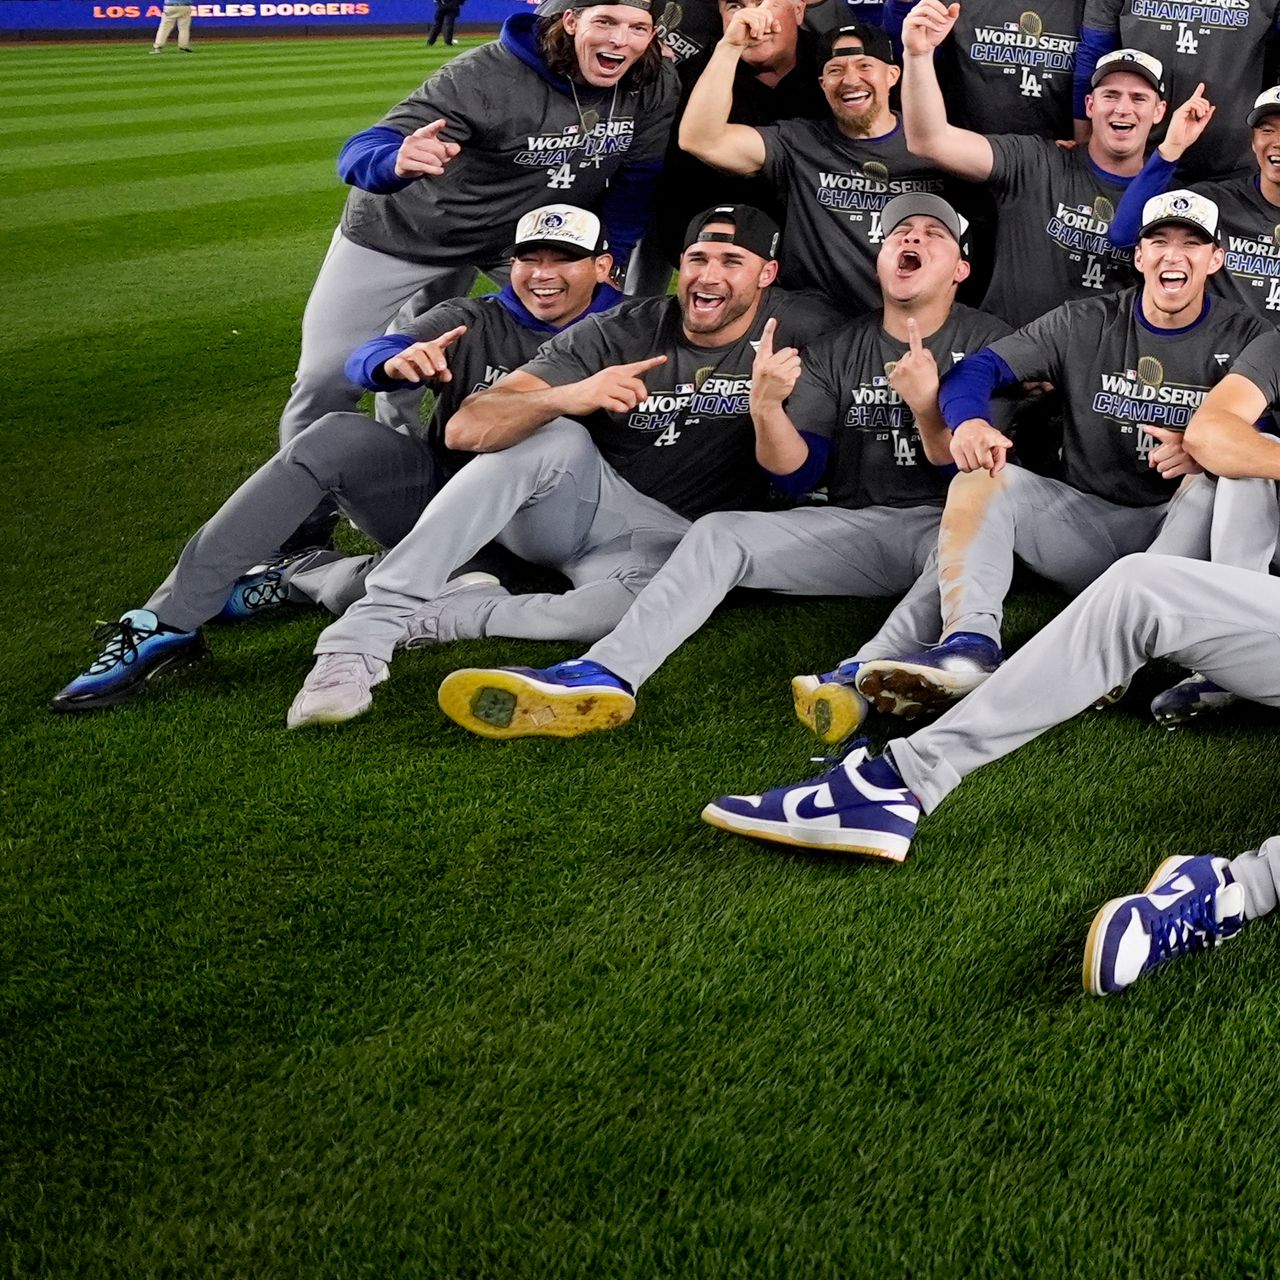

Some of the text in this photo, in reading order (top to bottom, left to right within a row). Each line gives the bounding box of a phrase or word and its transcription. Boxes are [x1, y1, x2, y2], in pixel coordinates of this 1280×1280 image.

[93, 5, 141, 19] LOS
[260, 2, 370, 16] DODGERS
[974, 27, 1037, 48] WORLD
[1176, 22, 1199, 55] LA
[1019, 66, 1043, 98] LA
